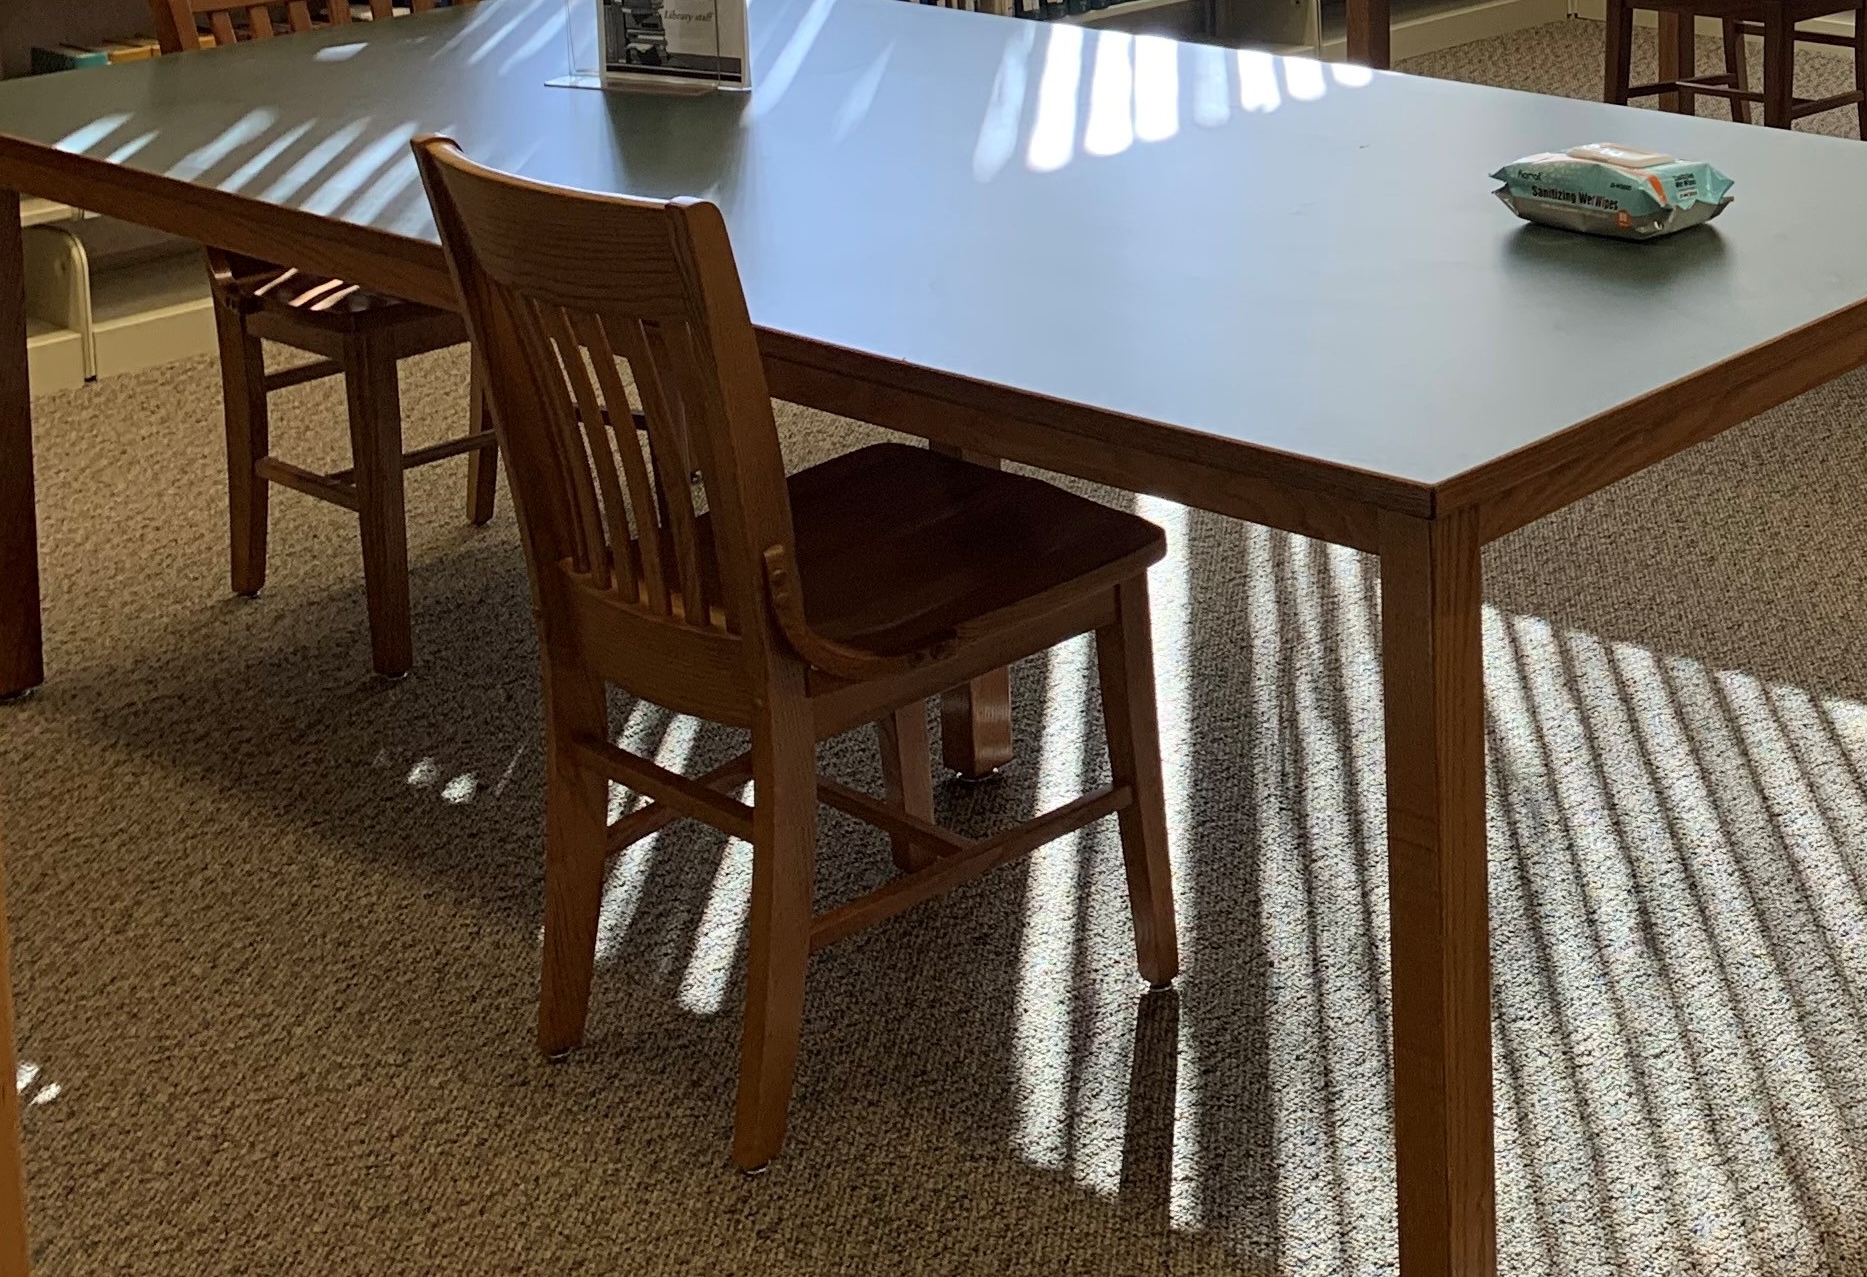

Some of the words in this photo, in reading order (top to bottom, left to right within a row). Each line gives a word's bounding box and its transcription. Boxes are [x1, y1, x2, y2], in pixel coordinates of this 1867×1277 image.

[664, 10, 693, 22] Library
[695, 12, 714, 22] staff
[1531, 185, 1577, 204] Sanitizing
[1579, 193, 1594, 205] Wet
[1598, 195, 1619, 210] Wipes
